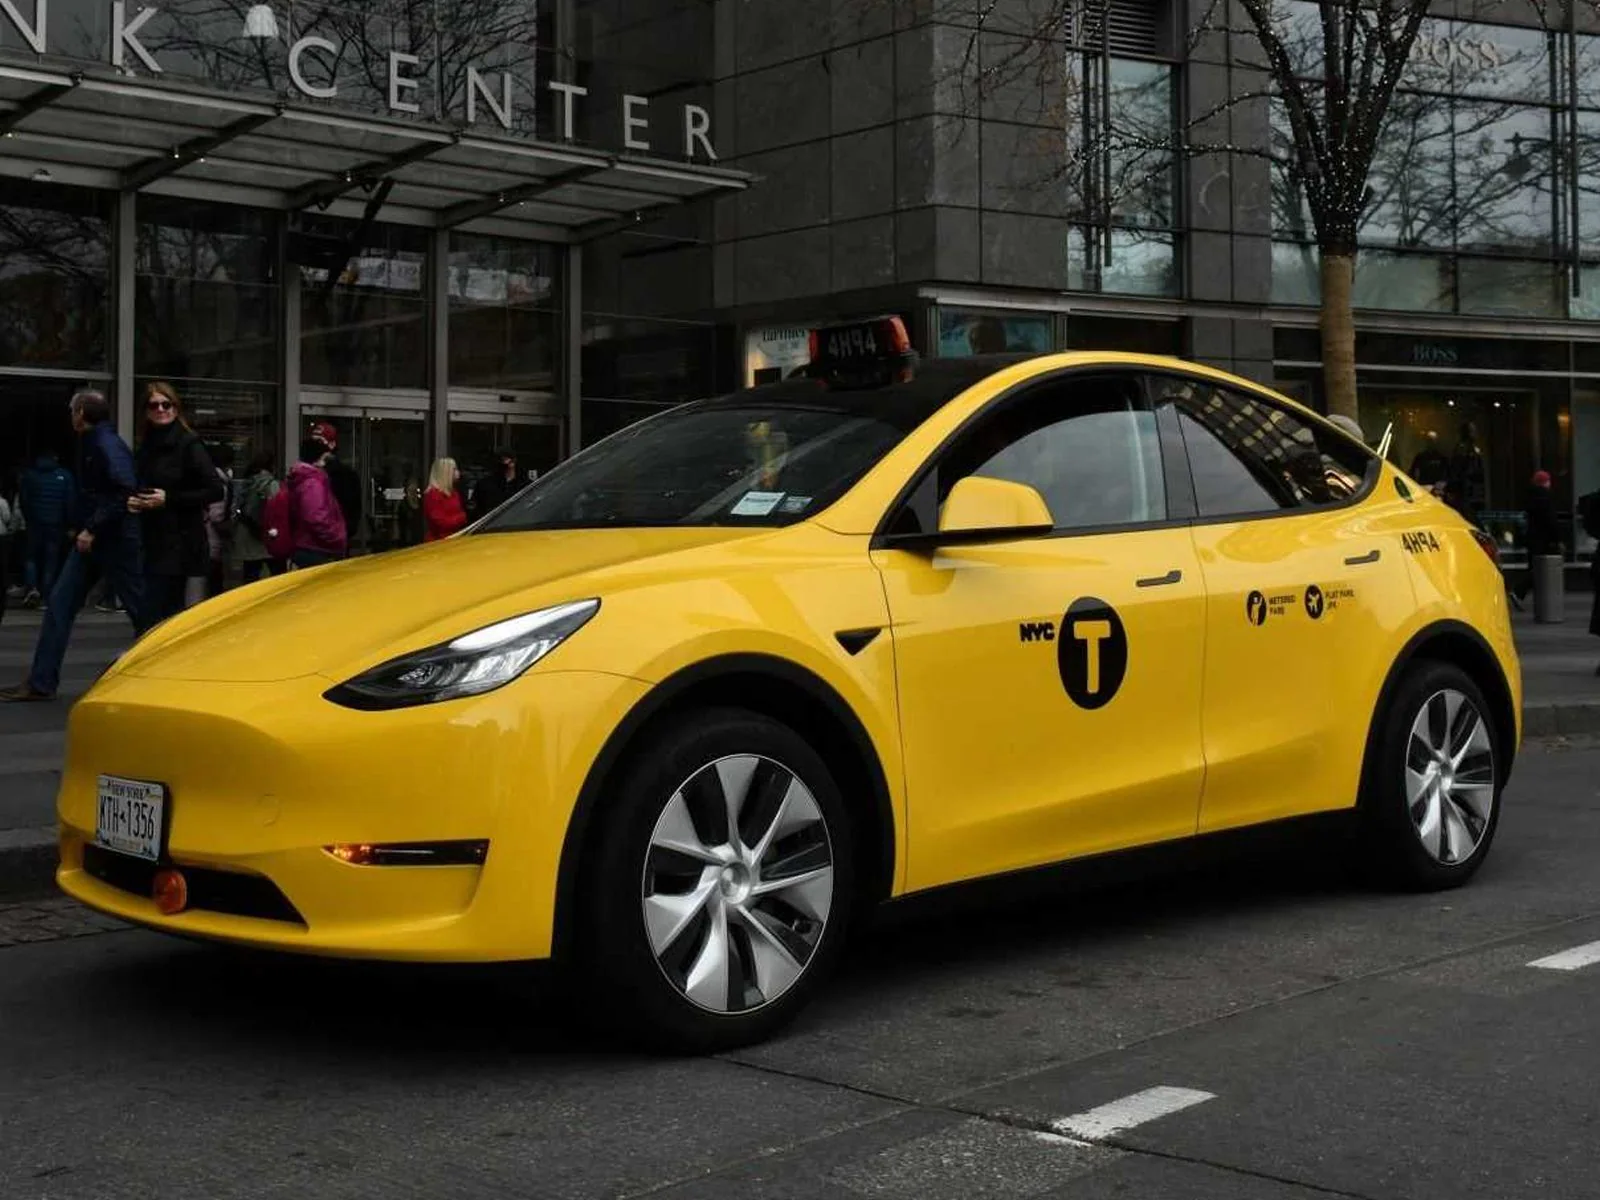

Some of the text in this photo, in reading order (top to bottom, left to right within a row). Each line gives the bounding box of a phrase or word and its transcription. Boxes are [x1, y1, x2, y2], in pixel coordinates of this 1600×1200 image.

[1409, 33, 1499, 69] BOSS
[289, 37, 717, 159] CENTER
[828, 326, 877, 360] 4H94
[1413, 343, 1458, 361] BOSS
[1020, 622, 1055, 642] NYC
[1073, 620, 1111, 694] T
